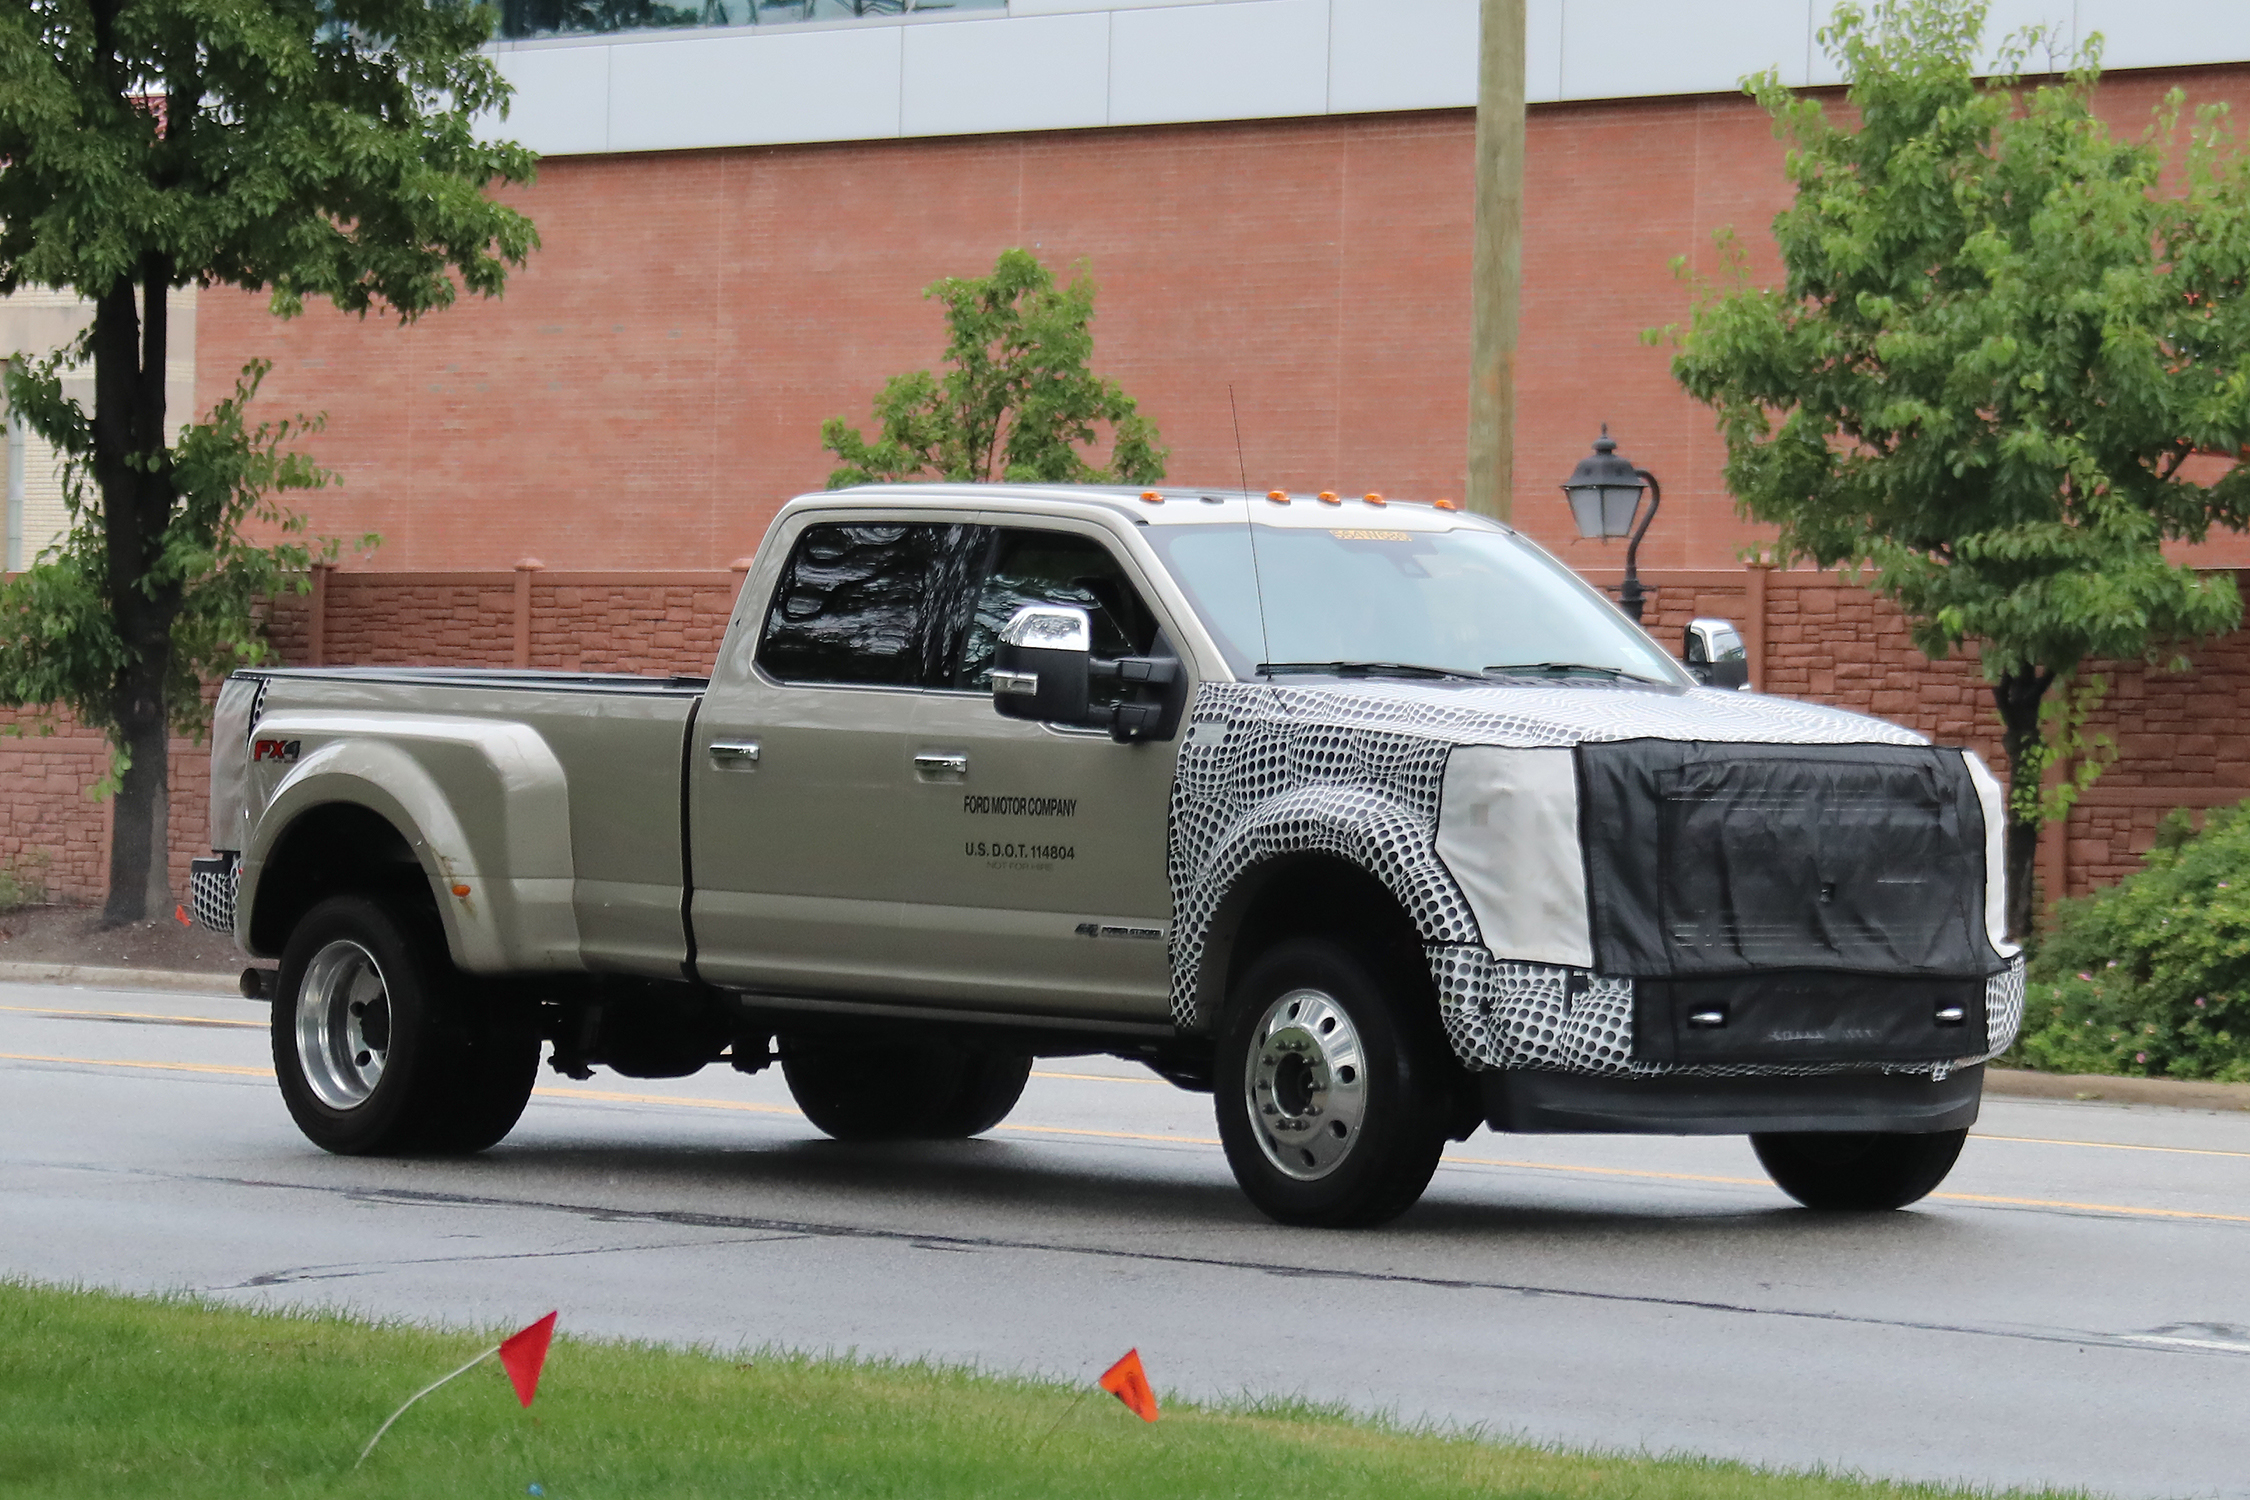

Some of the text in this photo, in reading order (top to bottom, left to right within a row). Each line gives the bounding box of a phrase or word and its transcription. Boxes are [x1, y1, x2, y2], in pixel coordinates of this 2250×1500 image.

[254, 740, 301, 761] FX4
[964, 795, 1077, 817] FORD MOTOR COMPANY
[965, 842, 1075, 860] U.S. D.O.T. 114804
